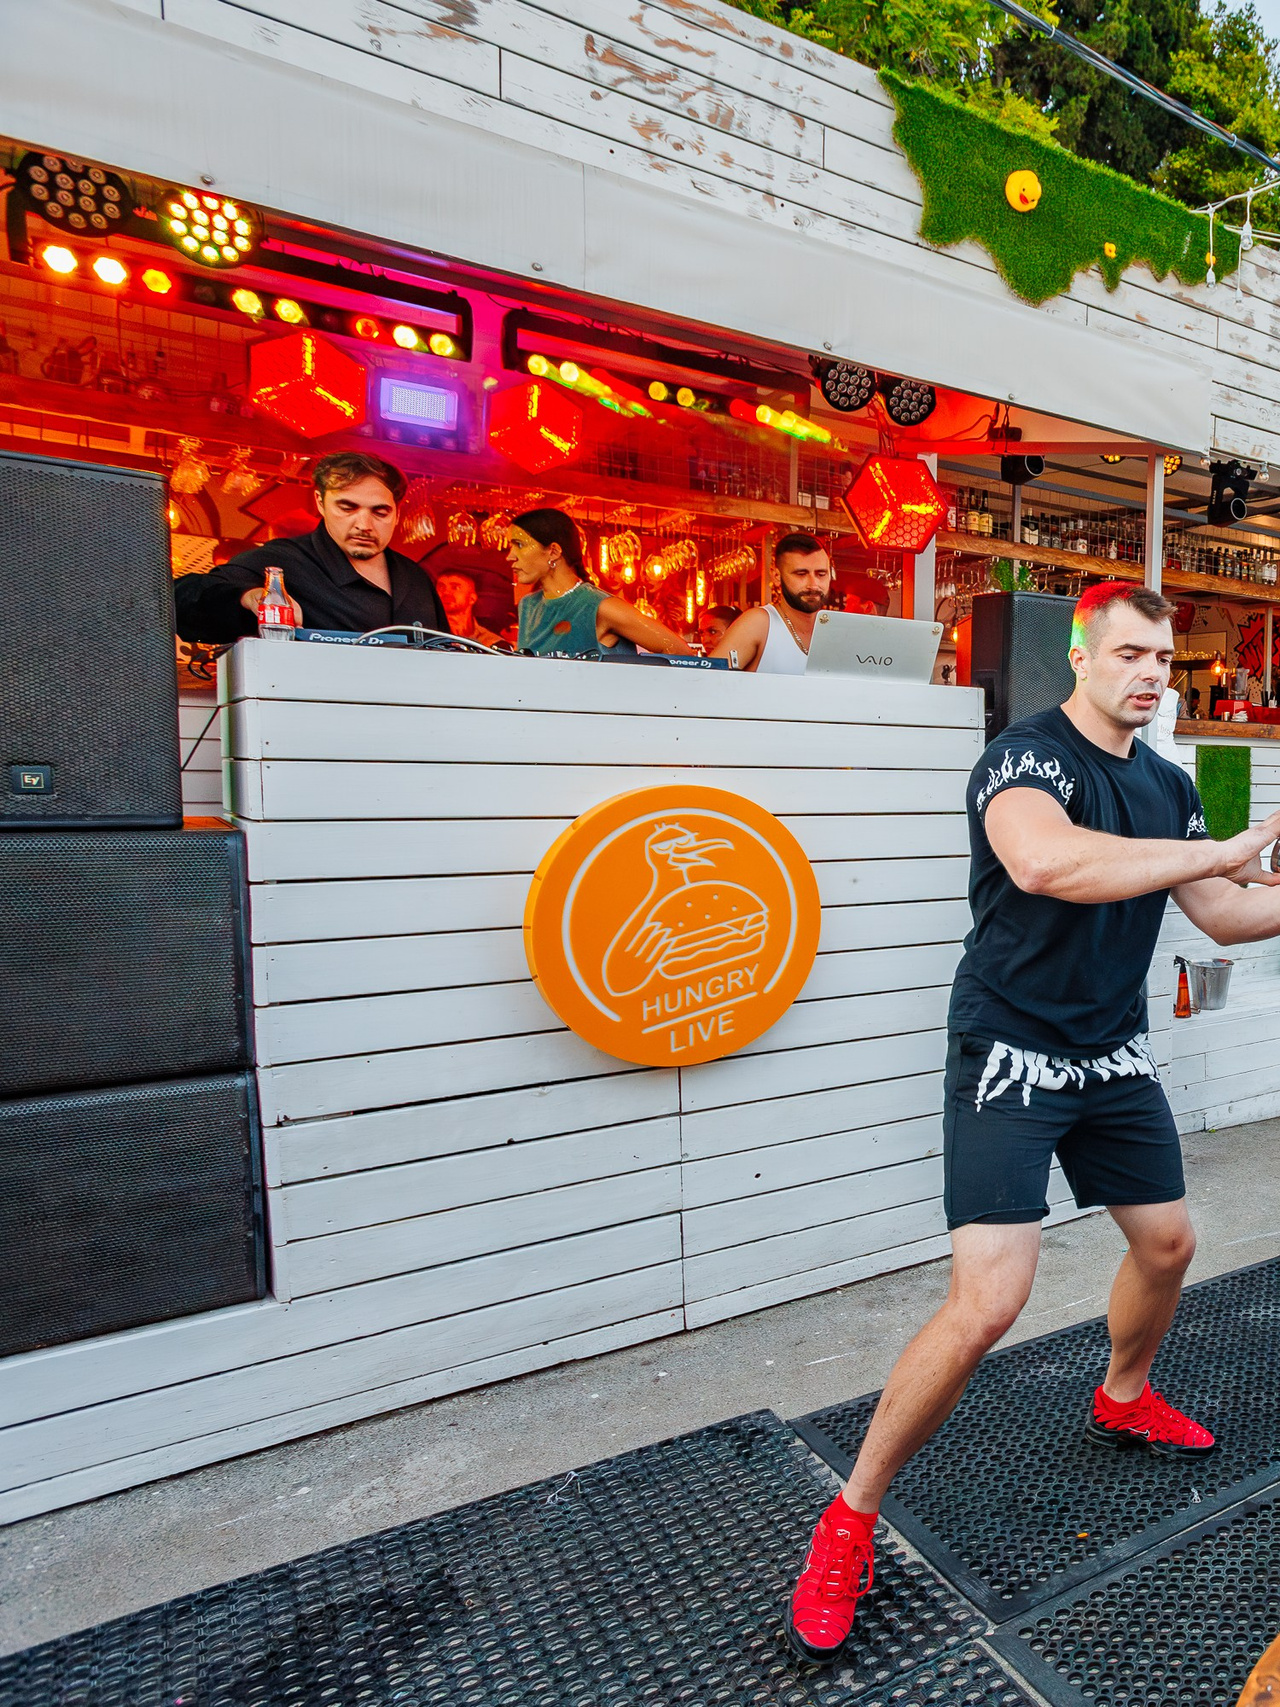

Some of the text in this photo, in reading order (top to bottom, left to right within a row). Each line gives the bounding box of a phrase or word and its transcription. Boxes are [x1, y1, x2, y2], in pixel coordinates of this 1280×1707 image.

[669, 659, 700, 667] oneer
[856, 654, 893, 666] VAIO
[642, 963, 760, 1021] HUNGRY
[669, 1010, 735, 1053] LIVE
